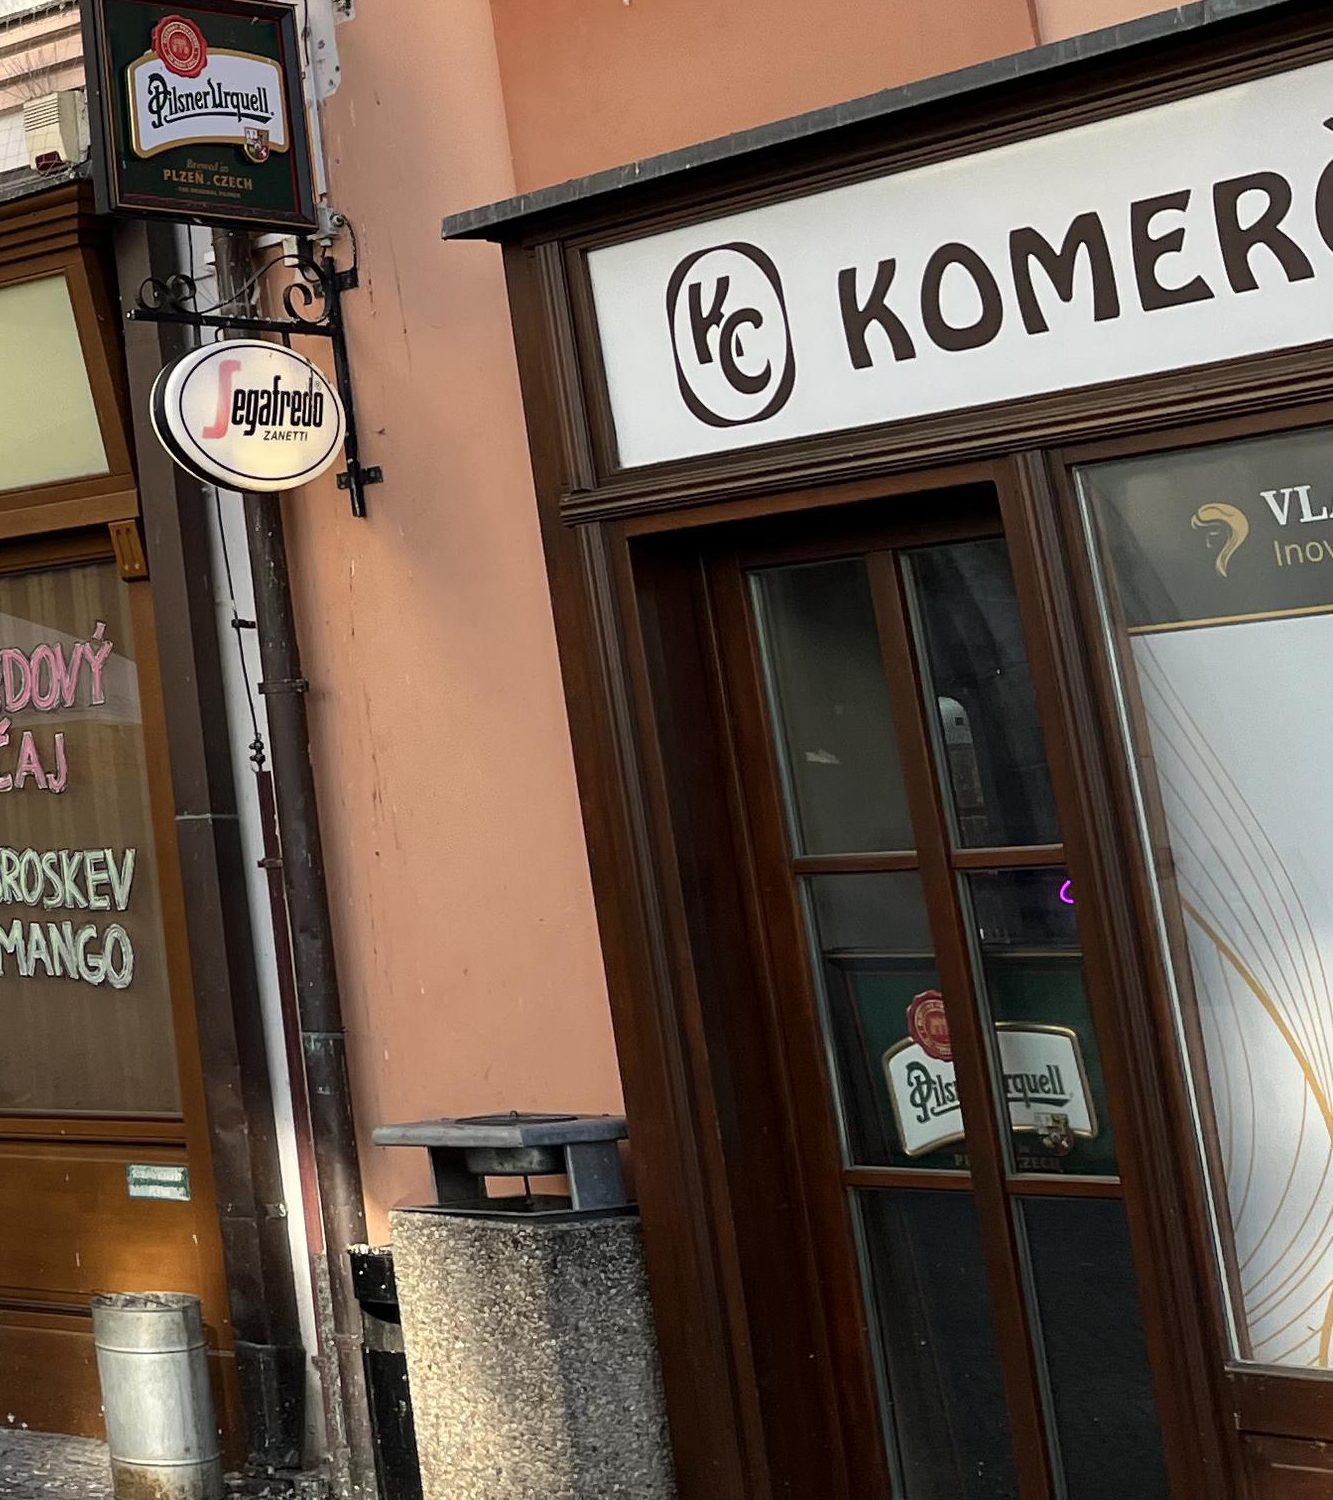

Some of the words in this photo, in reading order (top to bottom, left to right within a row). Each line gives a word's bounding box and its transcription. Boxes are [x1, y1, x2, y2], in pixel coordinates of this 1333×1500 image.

[837, 117, 1333, 370] KOMER
[201, 360, 324, 439] Segafredo
[262, 430, 308, 442] ZANETTI
[1260, 485, 1333, 526] VL
